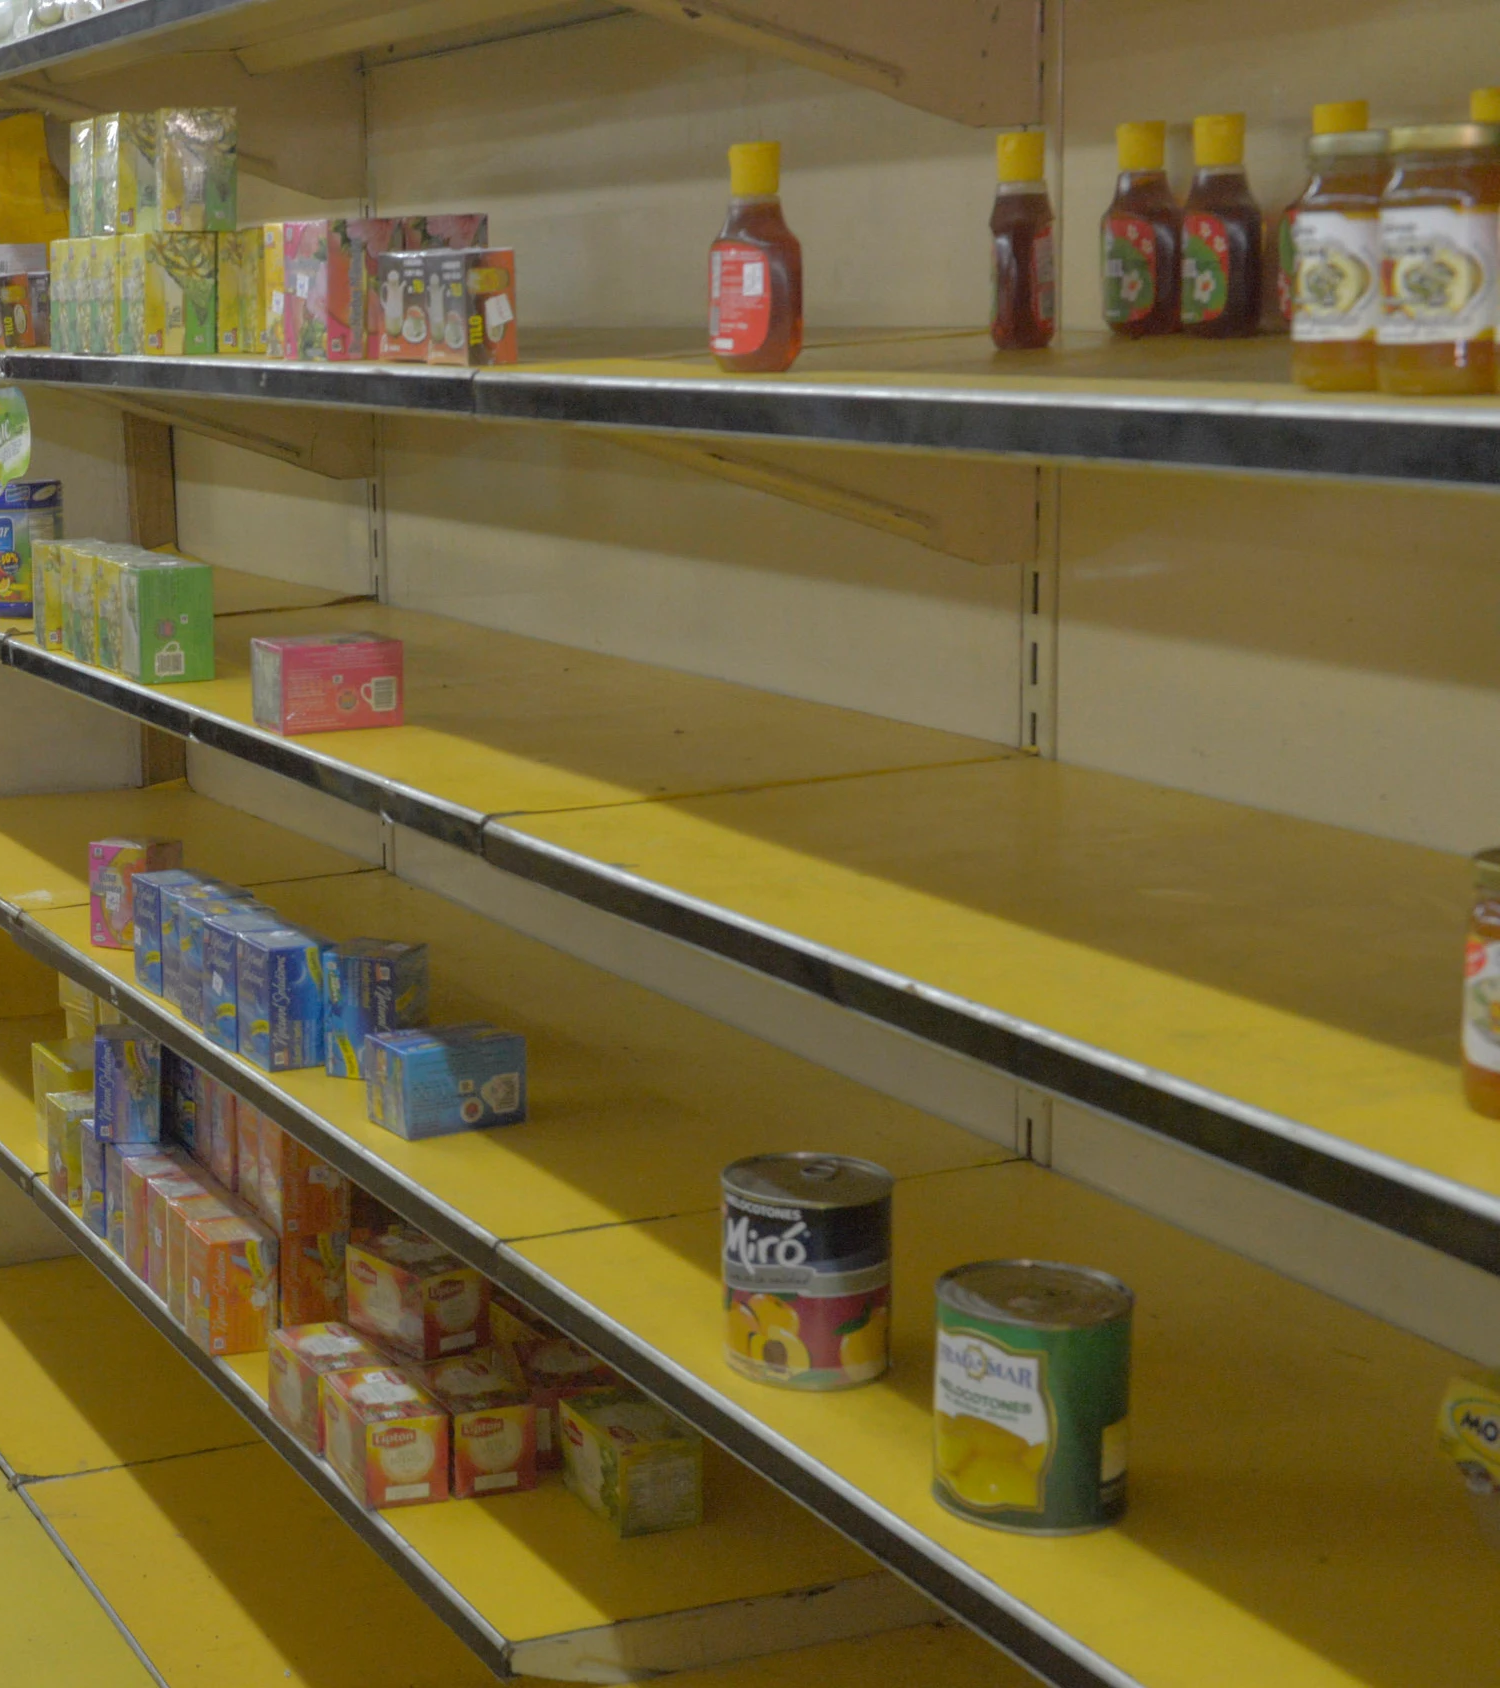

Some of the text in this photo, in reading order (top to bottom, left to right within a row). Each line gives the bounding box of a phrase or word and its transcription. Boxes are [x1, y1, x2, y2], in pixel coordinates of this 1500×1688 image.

[468, 313, 484, 347] TILO
[726, 1216, 808, 1275] Miró
[375, 1431, 415, 1447] Lipton
